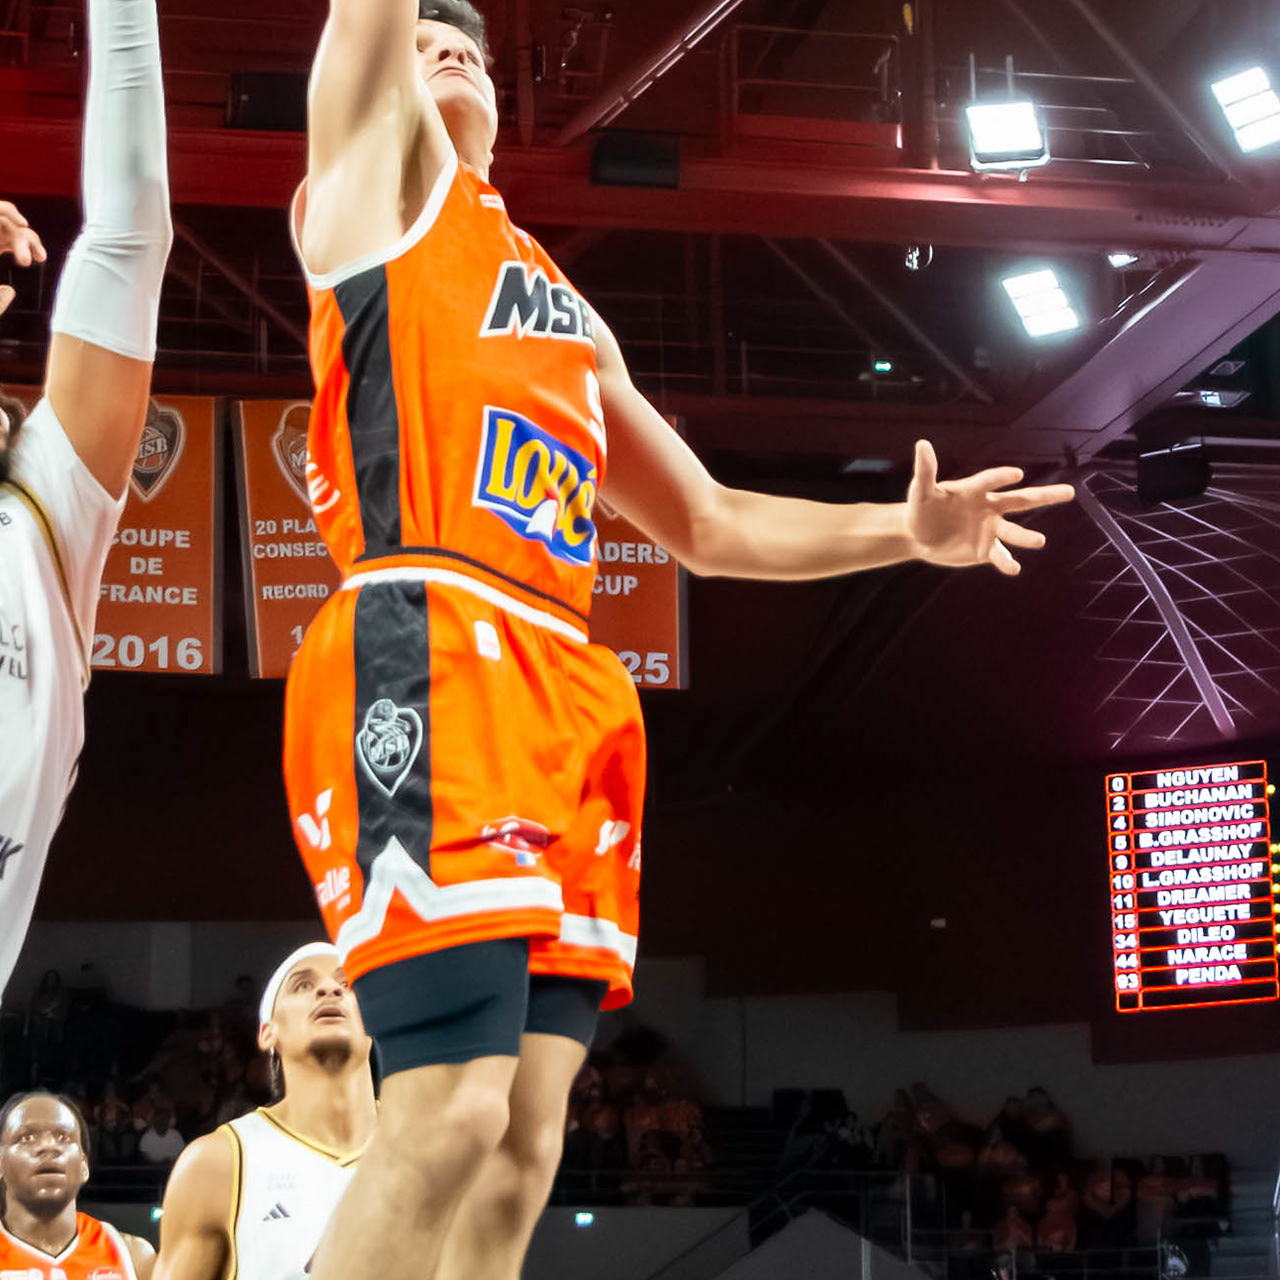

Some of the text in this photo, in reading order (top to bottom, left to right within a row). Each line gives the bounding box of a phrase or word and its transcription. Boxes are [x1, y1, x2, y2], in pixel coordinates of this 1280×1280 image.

[255, 520, 277, 536] 20
[130, 557, 163, 575] DE
[98, 585, 198, 606] FRANCE
[262, 584, 329, 600] RECORD
[591, 575, 638, 596] CUP
[91, 634, 204, 671] 2016
[618, 651, 671, 686] 25
[1112, 766, 1239, 791] 0 NGUYEN
[1113, 784, 1252, 811] 2 BUCHANAN
[1113, 804, 1254, 830] 4 SIMONOVIC
[1115, 822, 1262, 850] 5 B.GRASSHOF
[1151, 844, 1253, 866] DELAUNAY
[1113, 863, 1263, 890] 10 L.GRASSHOF
[1114, 884, 1251, 909] 11 DREAMER
[1115, 904, 1251, 929] 15 YEGUETE
[1115, 925, 1235, 948] 34 DILEO
[1116, 944, 1247, 968] 44 NARACE
[1176, 965, 1242, 985] PENDA
